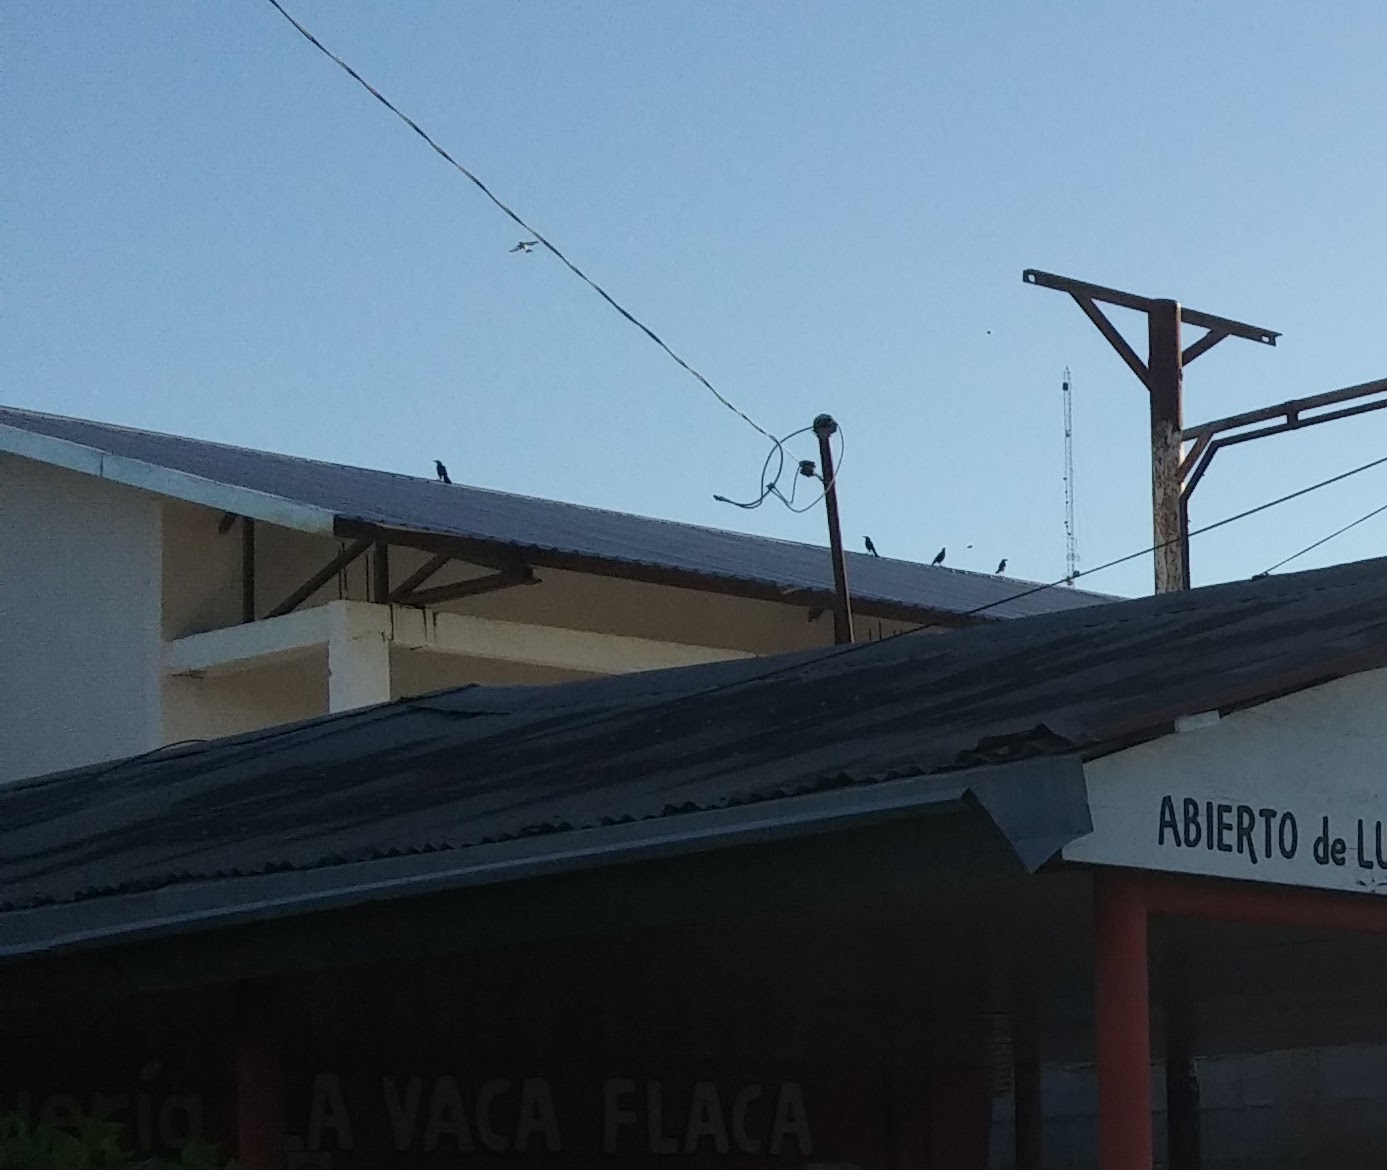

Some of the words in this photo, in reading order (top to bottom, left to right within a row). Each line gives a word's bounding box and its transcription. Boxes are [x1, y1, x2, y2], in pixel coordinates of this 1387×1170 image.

[1158, 795, 1298, 865] ABIERTO
[1313, 816, 1346, 866] de
[381, 1073, 563, 1152] VACA
[602, 1077, 813, 1155] FLACA
